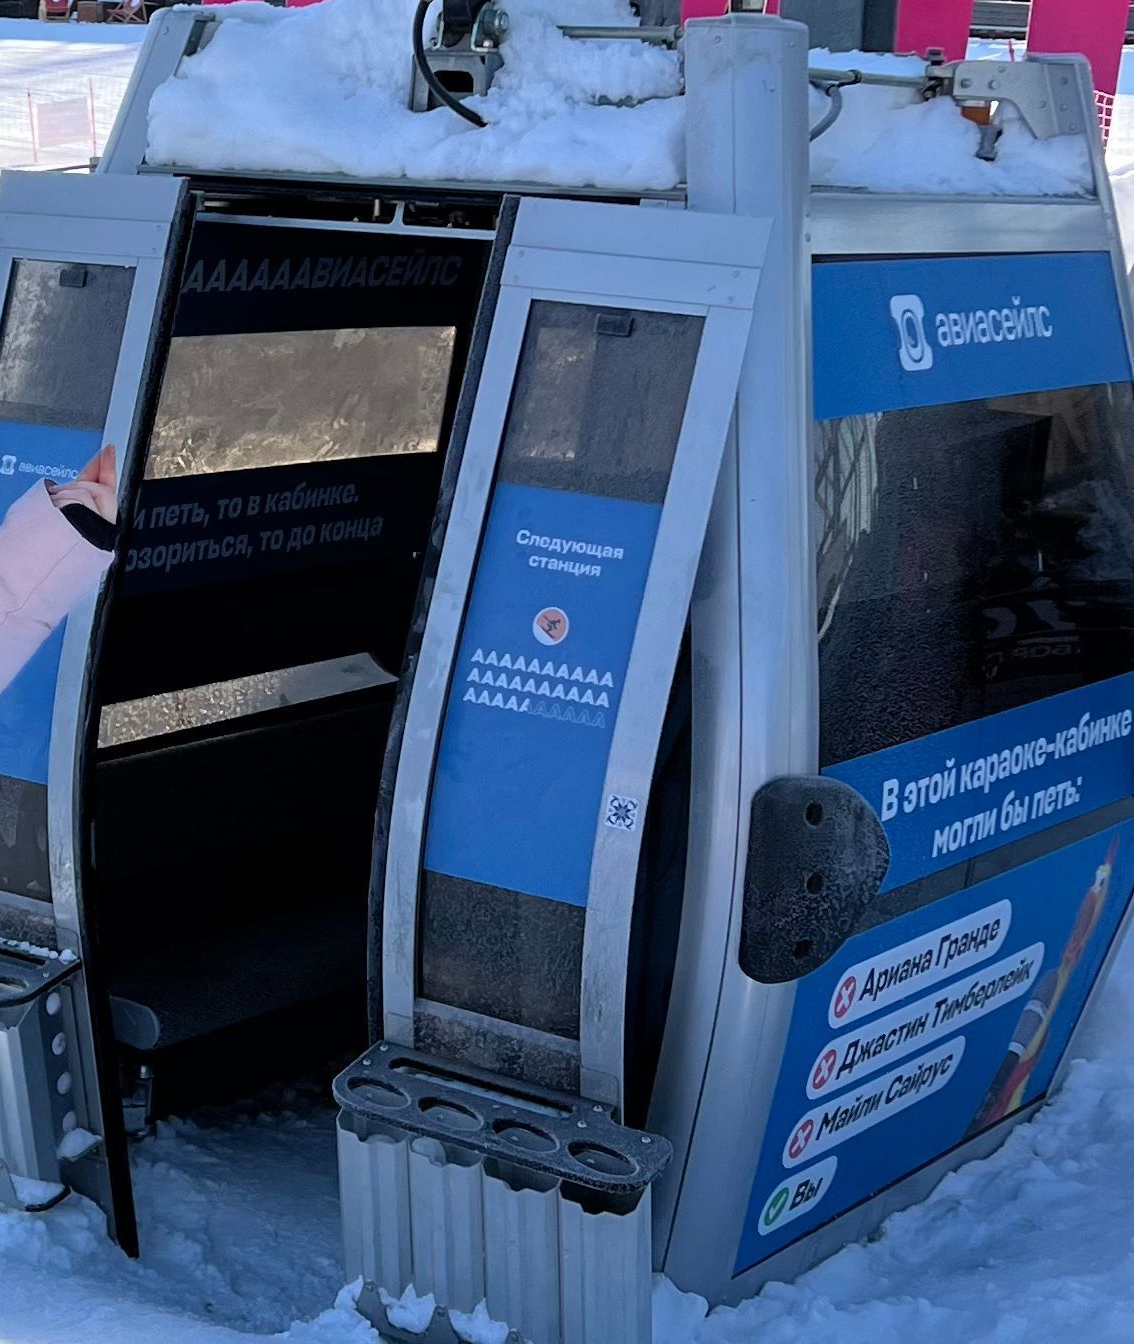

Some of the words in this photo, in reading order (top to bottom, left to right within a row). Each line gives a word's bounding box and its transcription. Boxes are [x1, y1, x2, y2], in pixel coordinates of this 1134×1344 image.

[935, 295, 1053, 347] авиасейлс
[18, 462, 79, 480] авиасейлс
[149, 501, 210, 529] петь,
[217, 496, 243, 520] то
[246, 495, 261, 517] в
[264, 482, 359, 515] кабинке.
[259, 528, 284, 553] то
[286, 524, 314, 553] до
[319, 514, 385, 544] конца
[516, 529, 625, 560] Следующая
[528, 554, 602, 577] станция
[880, 777, 900, 822] В
[903, 757, 957, 814] этой
[959, 708, 1133, 794] караоке-кабинке
[931, 807, 999, 858] могли
[1000, 789, 1030, 832] бы
[1030, 775, 1083, 820] петь:
[858, 948, 934, 1002] Ариана
[935, 918, 1002, 969] Гранде
[835, 1012, 930, 1080] Джастин
[931, 958, 1036, 1029] Тимберлейк
[815, 1089, 885, 1141] Майли
[885, 1054, 954, 1106] Сайрус
[789, 1177, 824, 1211] Вы
